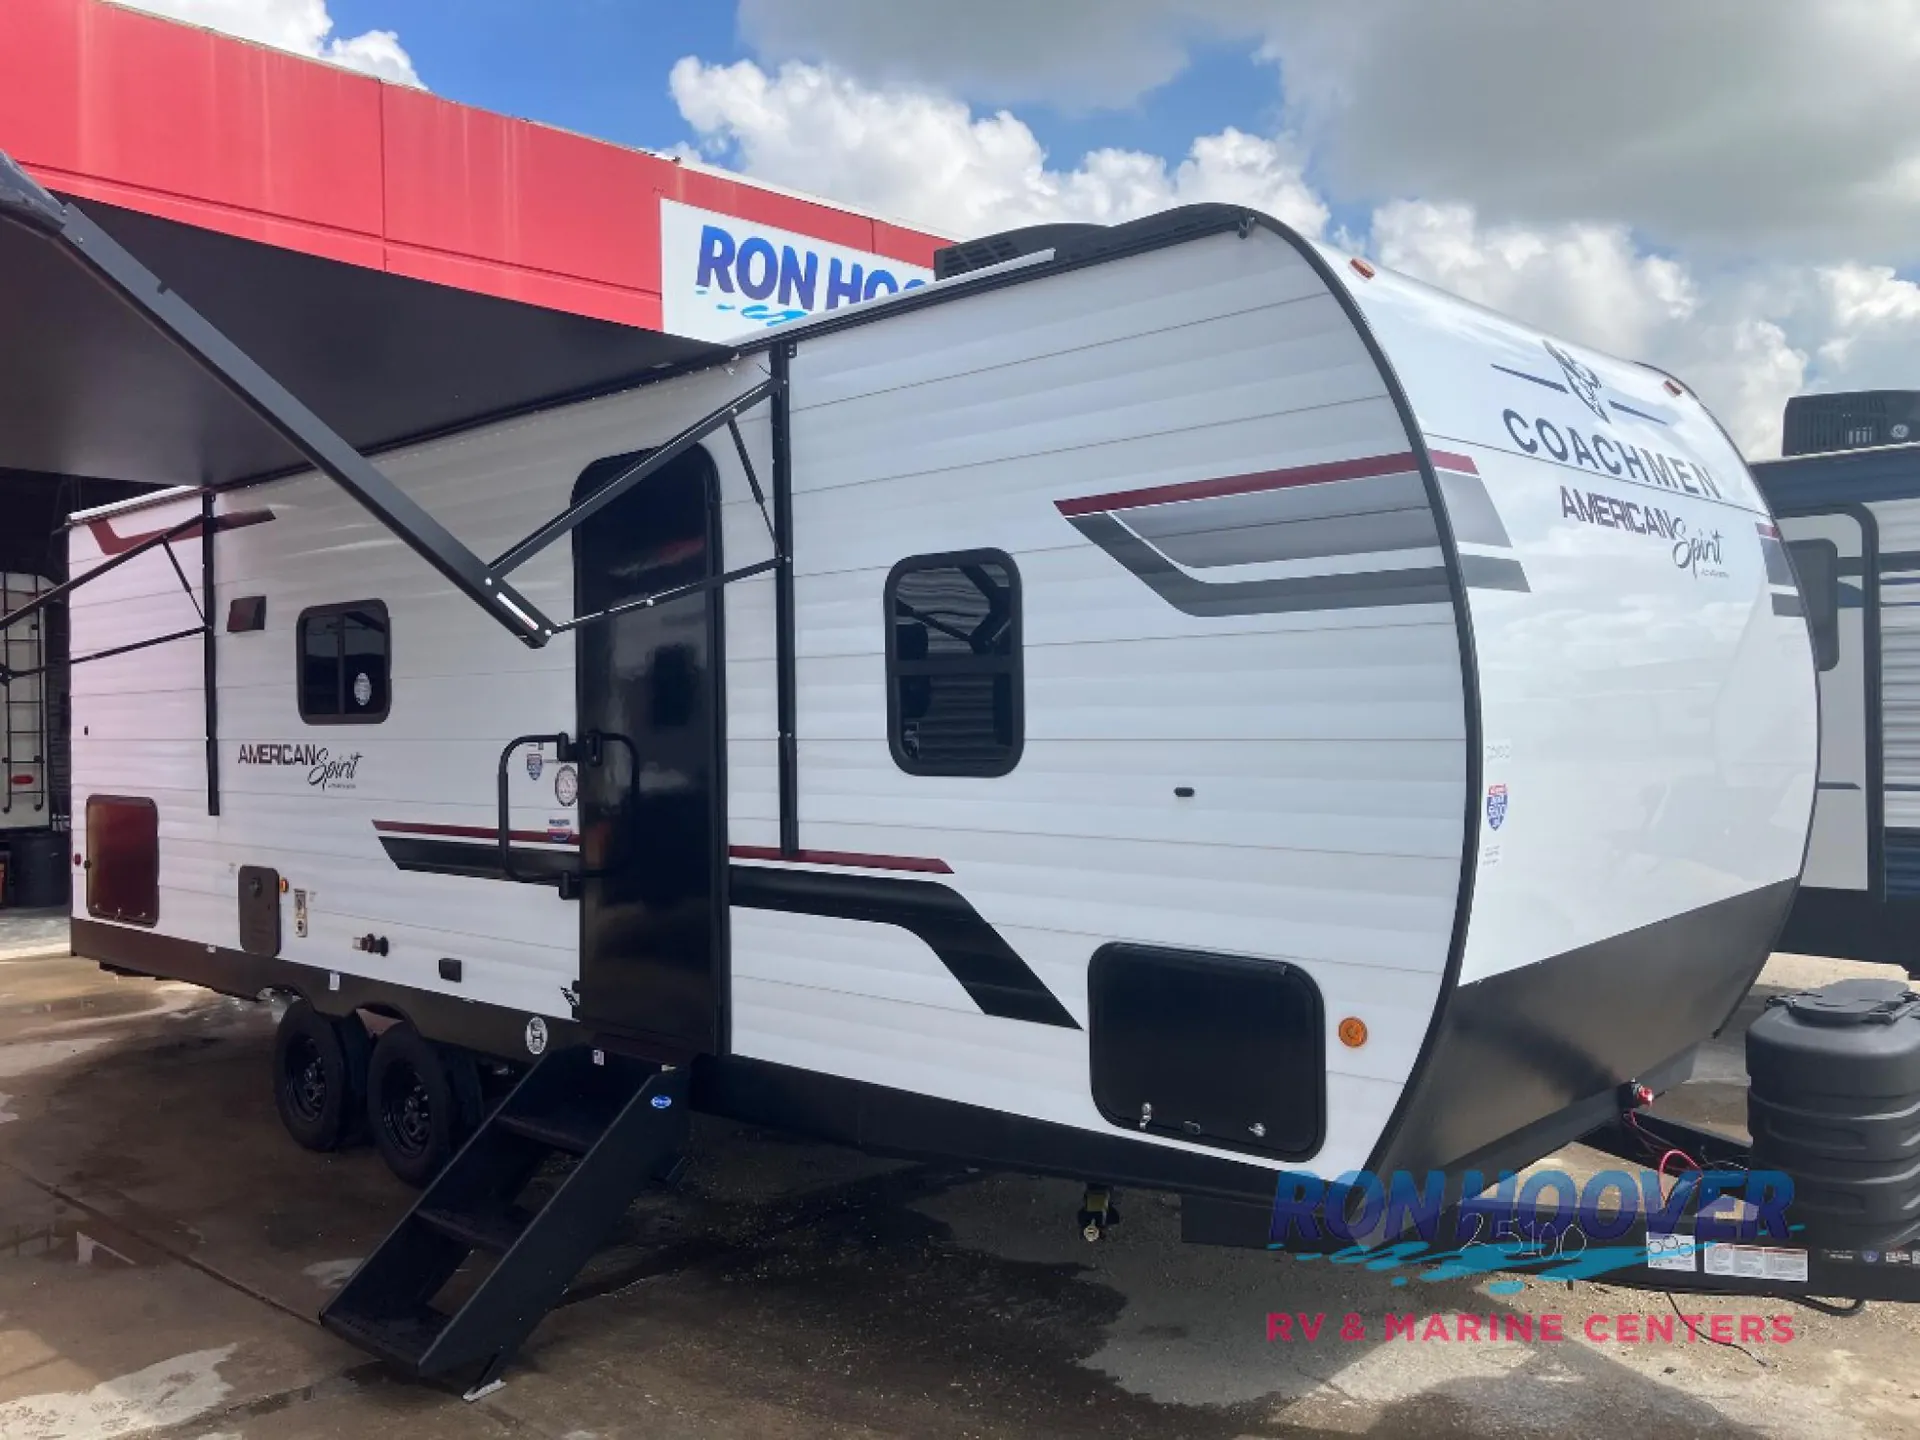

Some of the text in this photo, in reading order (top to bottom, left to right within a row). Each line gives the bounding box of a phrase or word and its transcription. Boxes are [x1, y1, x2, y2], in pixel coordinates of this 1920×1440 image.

[696, 224, 927, 312] RON HO
[1503, 408, 1722, 500] COACHMEN
[1560, 485, 1725, 580] AMERICAN Spirit
[238, 743, 364, 791] AMERICAN Spirit
